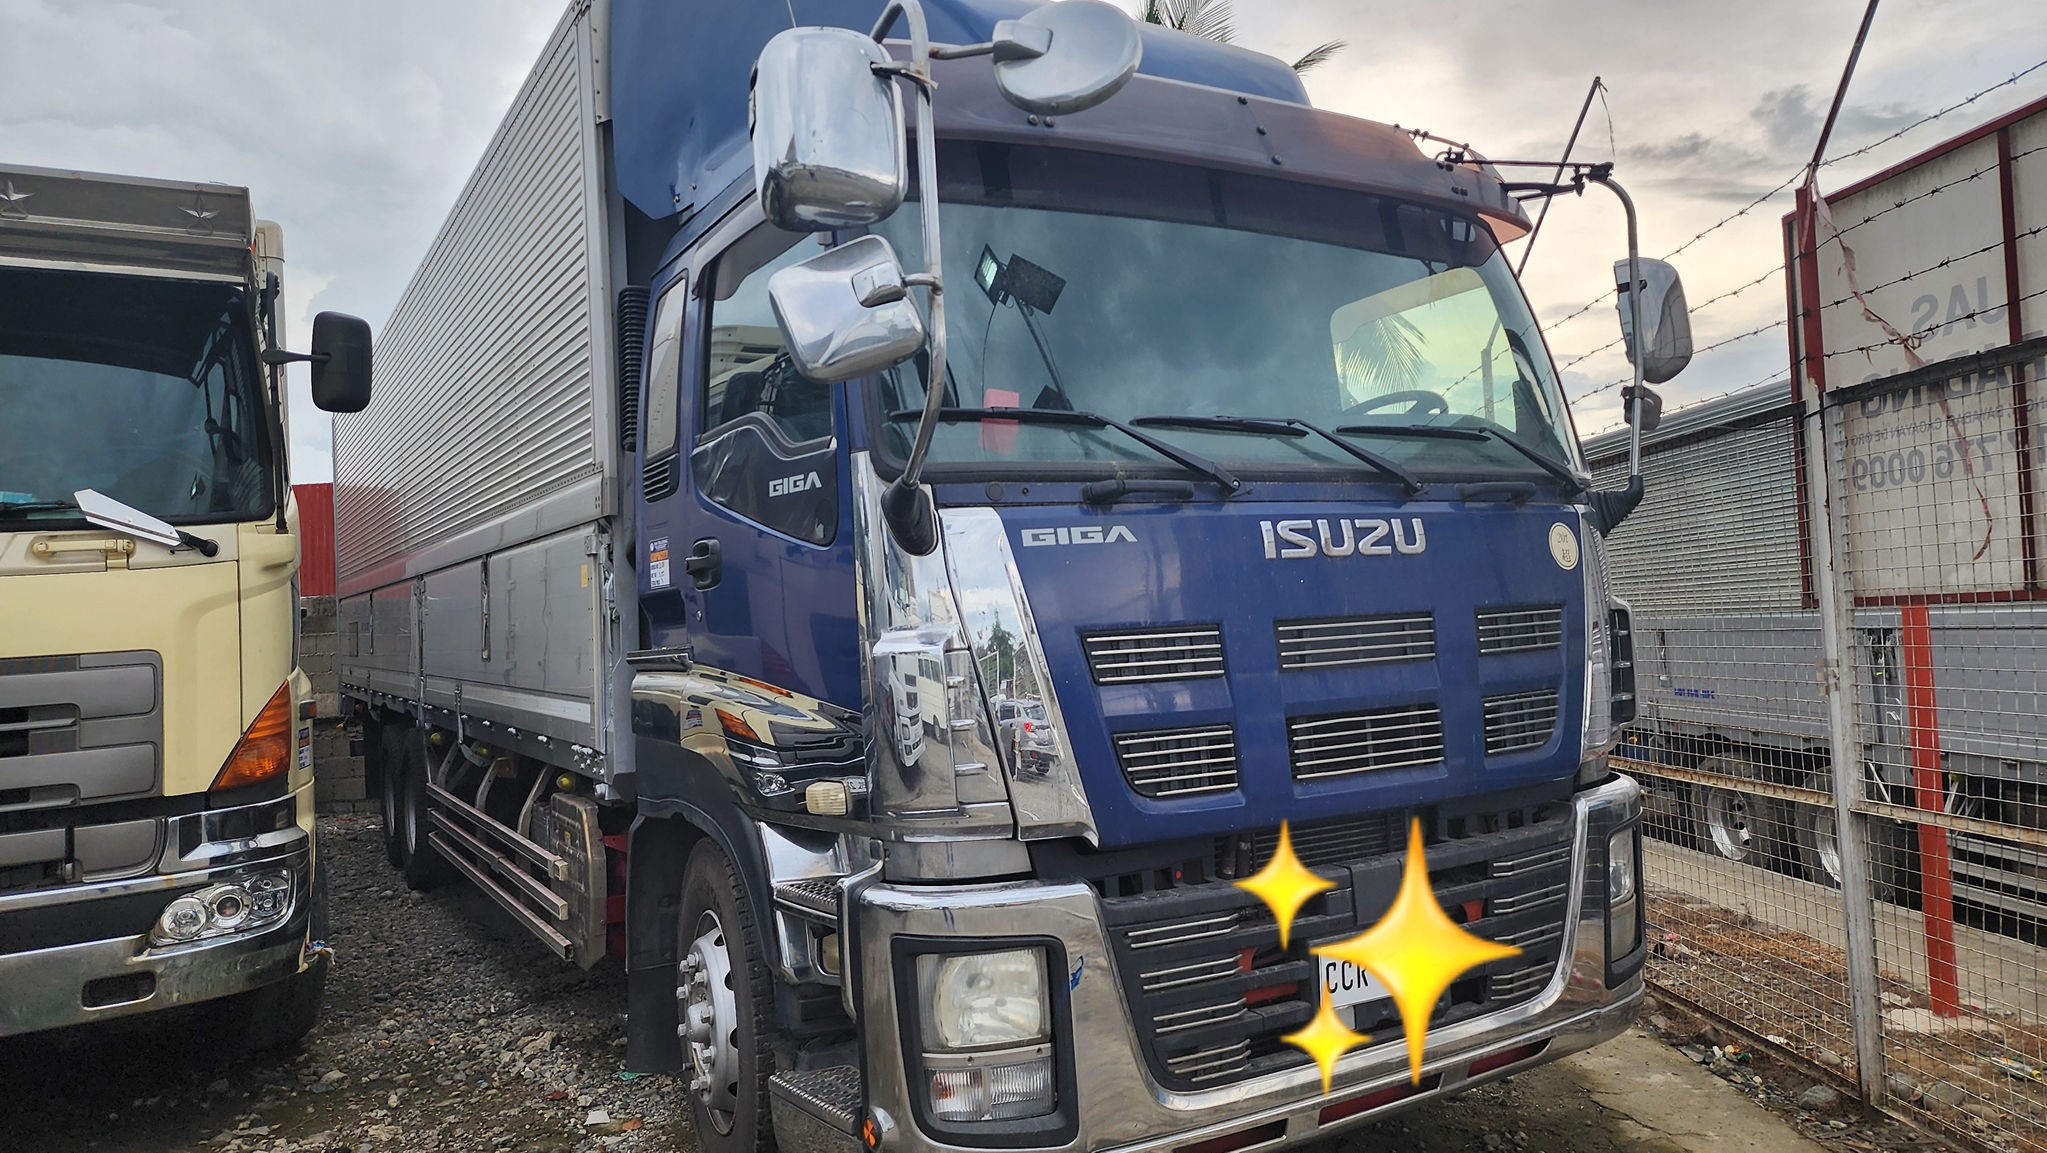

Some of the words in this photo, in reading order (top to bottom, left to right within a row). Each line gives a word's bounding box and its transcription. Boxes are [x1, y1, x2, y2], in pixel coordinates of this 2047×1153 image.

[769, 471, 822, 497] GIGA
[1021, 526, 1138, 547] GIGA
[1259, 518, 1427, 559] ISUZU
